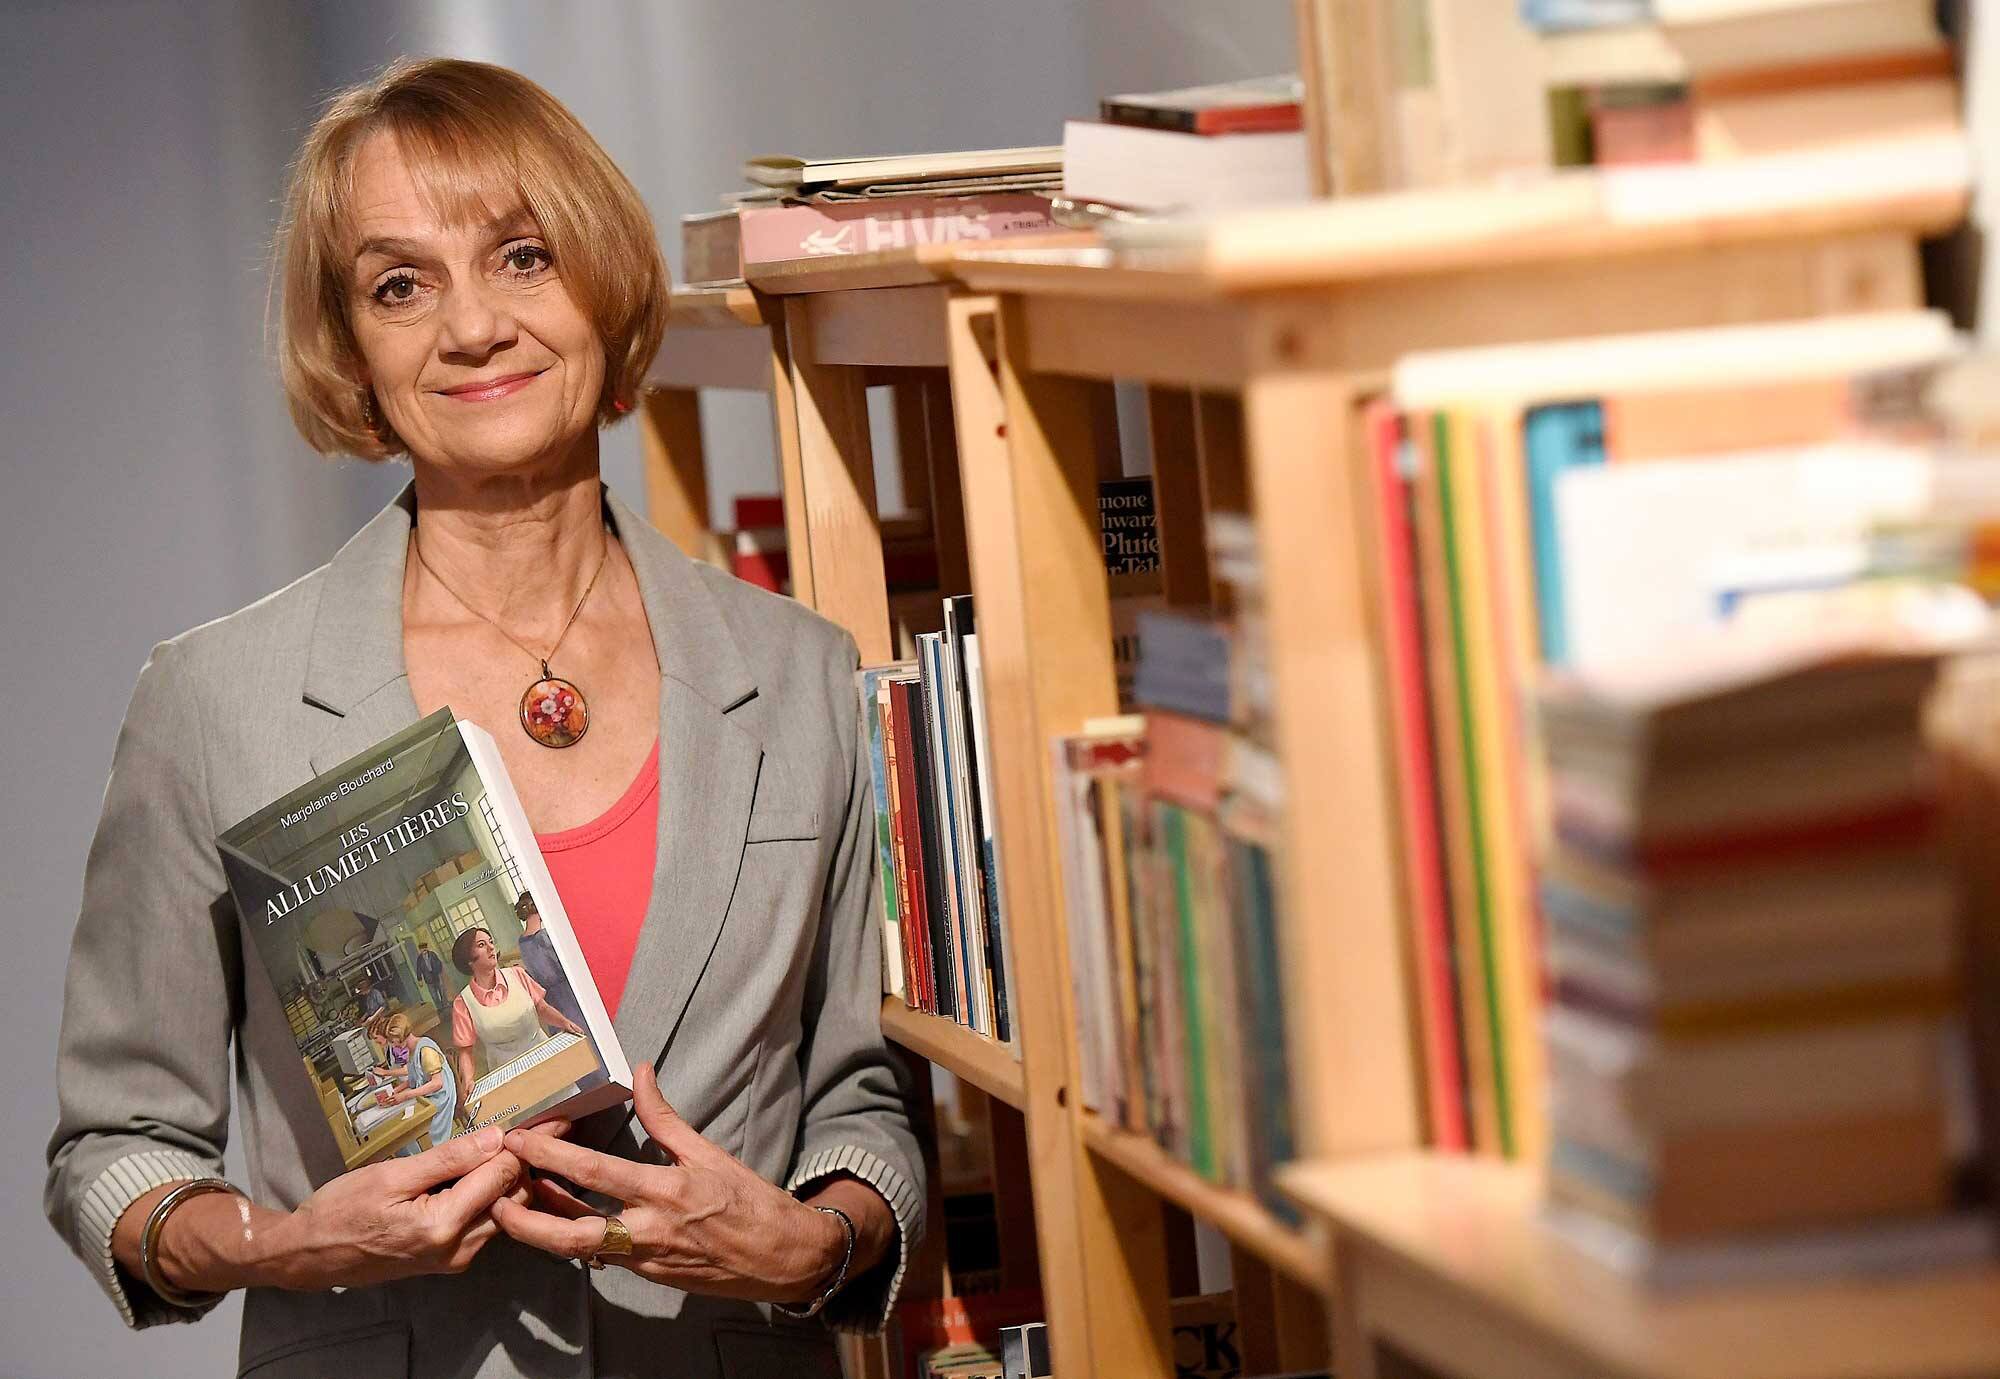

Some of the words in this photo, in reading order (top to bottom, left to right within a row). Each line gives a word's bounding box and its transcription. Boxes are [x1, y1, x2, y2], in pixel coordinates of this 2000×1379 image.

[1101, 532, 1160, 555] Pluie
[280, 790, 338, 829] Marjolaine
[338, 757, 394, 796] Bouchard
[265, 791, 471, 926] ALLUMETTIÈRES
[339, 822, 370, 849] LES
